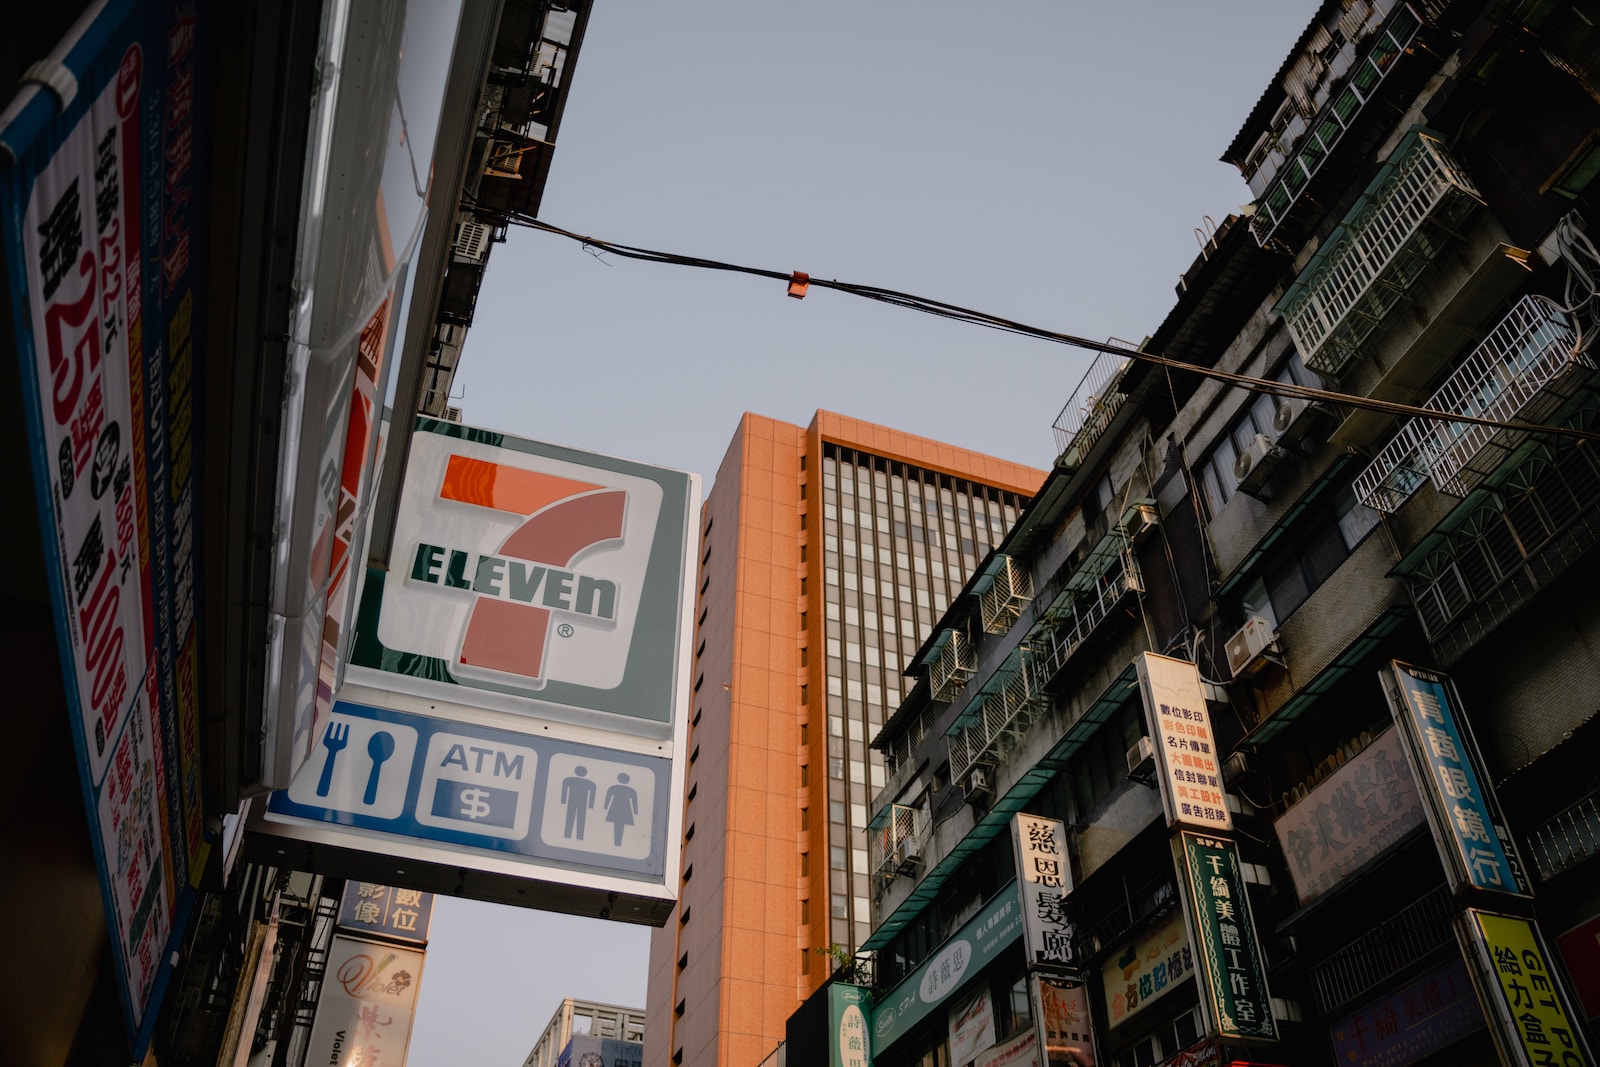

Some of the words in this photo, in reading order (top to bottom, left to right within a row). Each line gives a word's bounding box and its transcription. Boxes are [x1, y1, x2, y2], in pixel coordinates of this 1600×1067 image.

[1160, 703, 1204, 723] 數位影印
[1167, 735, 1211, 755] 名片傳單
[440, 743, 524, 781] ATM
[1178, 785, 1222, 805] 美工設計
[1181, 802, 1227, 822] 廣告招牌
[1196, 837, 1225, 850] SPA
[1027, 822, 1074, 964] 慈恩髮廊
[1204, 854, 1257, 1023] 千綺美體工作室
[927, 946, 965, 996] 詩薇思
[1521, 949, 1562, 1016] GET
[897, 990, 917, 1018] SPA
[330, 1030, 347, 1066] Violet
